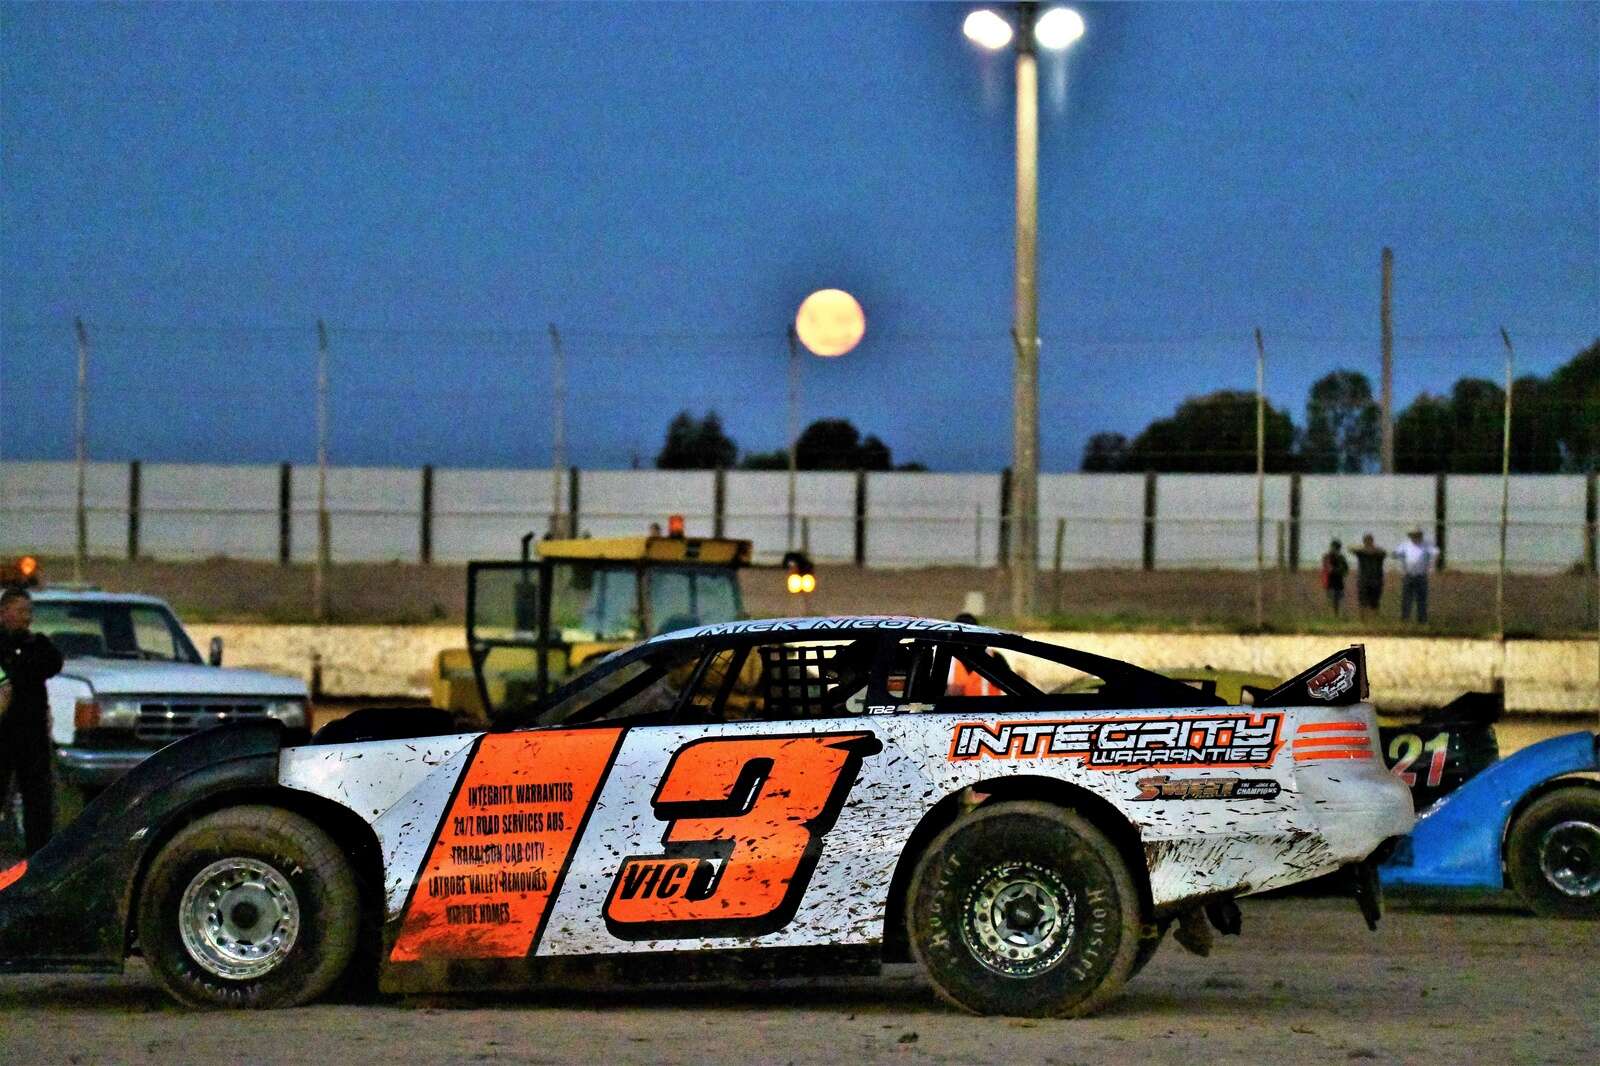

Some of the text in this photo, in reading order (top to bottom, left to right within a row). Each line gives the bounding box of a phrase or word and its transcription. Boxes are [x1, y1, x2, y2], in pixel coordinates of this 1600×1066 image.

[696, 622, 792, 636] MICK
[868, 705, 896, 715] TB2
[956, 719, 1277, 755] INTEGRITY
[1092, 747, 1270, 764] WARRANTIES
[1388, 732, 1450, 787] 21
[468, 782, 573, 806] INTEGRITY WARRANTIES
[476, 814, 500, 835] ROAD
[502, 812, 544, 834] SERVICES
[546, 811, 564, 832] AUS
[602, 730, 883, 941] 3
[525, 842, 545, 861] CITY
[429, 874, 467, 897] LATROBE
[469, 873, 499, 895] VALLEY
[620, 863, 688, 899] VIC
